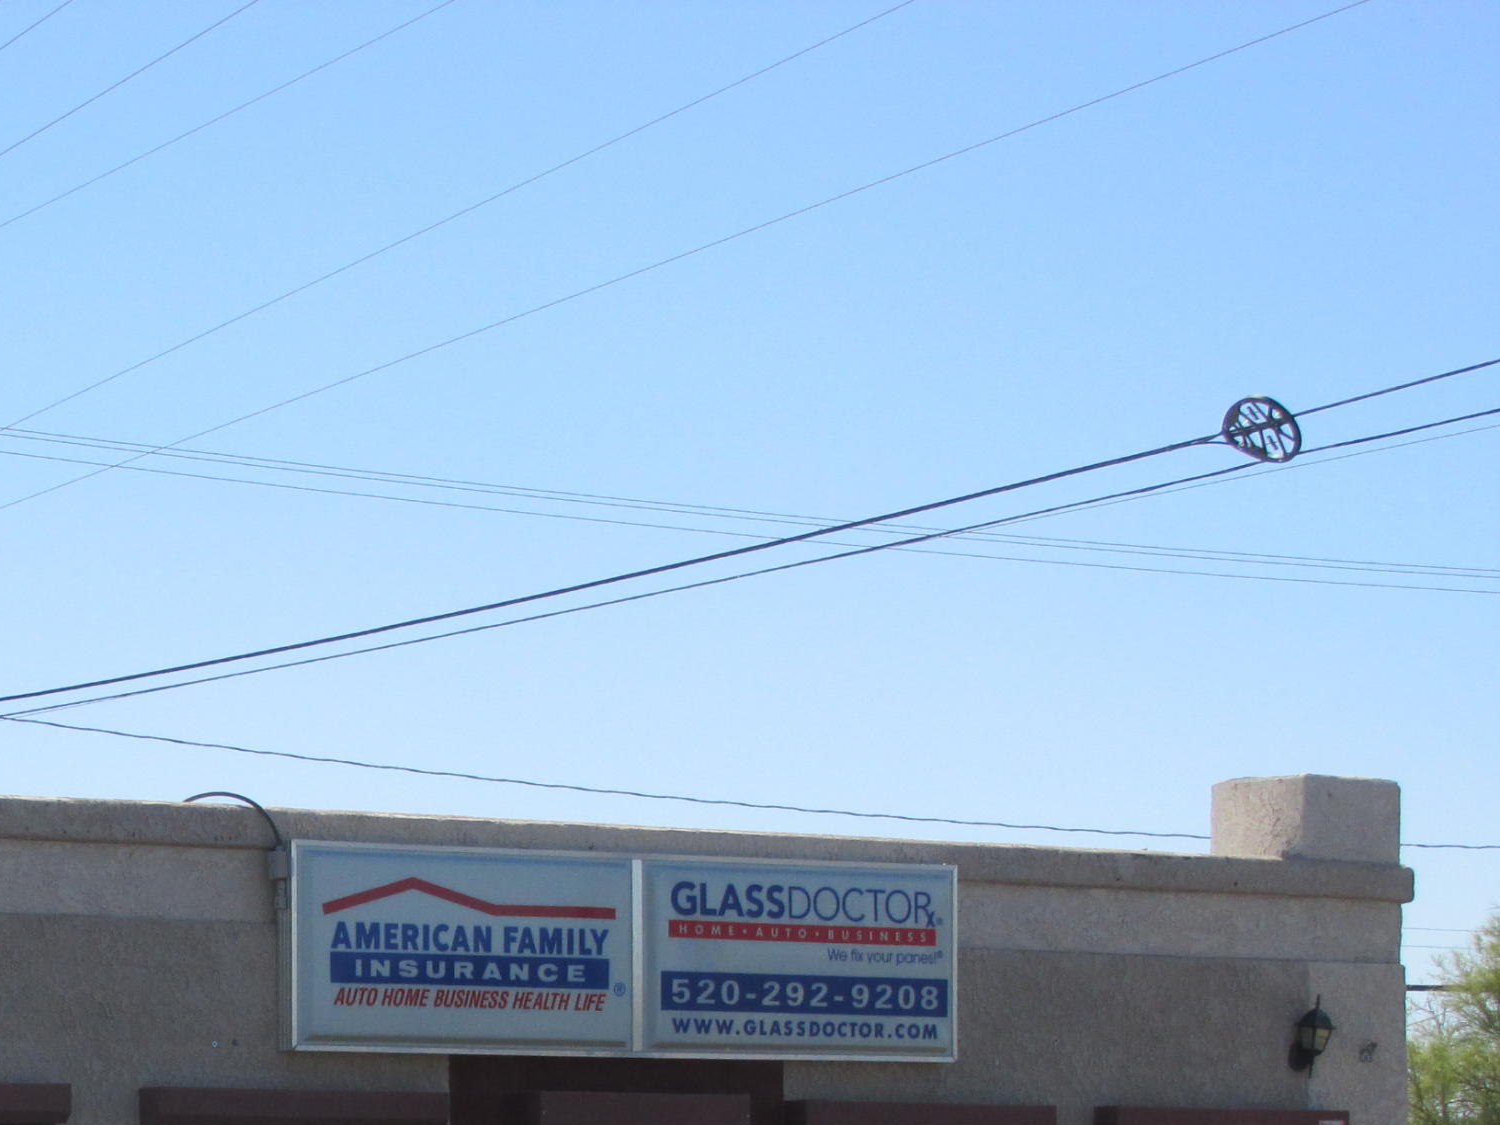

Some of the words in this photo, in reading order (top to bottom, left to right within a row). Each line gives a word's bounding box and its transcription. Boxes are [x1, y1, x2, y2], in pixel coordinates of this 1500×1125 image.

[331, 921, 493, 953] AMERICAN
[503, 926, 610, 956] FAMILY
[678, 924, 736, 936] HOME
[755, 927, 808, 939] AUTO
[827, 930, 928, 943] BUSINESS
[827, 949, 848, 962] We
[850, 949, 864, 962] fix
[867, 953, 893, 966] your
[355, 958, 586, 983] INSURANCE
[334, 986, 378, 1006] AUTO
[382, 987, 430, 1008] HOME
[433, 989, 510, 1010] BUSINESS
[509, 991, 572, 1011] HEALTH
[574, 993, 607, 1012] LIFE
[671, 979, 939, 1010] 520-292-9208
[672, 1018, 939, 1040] WWW.GLASSDOCTOR.COM
